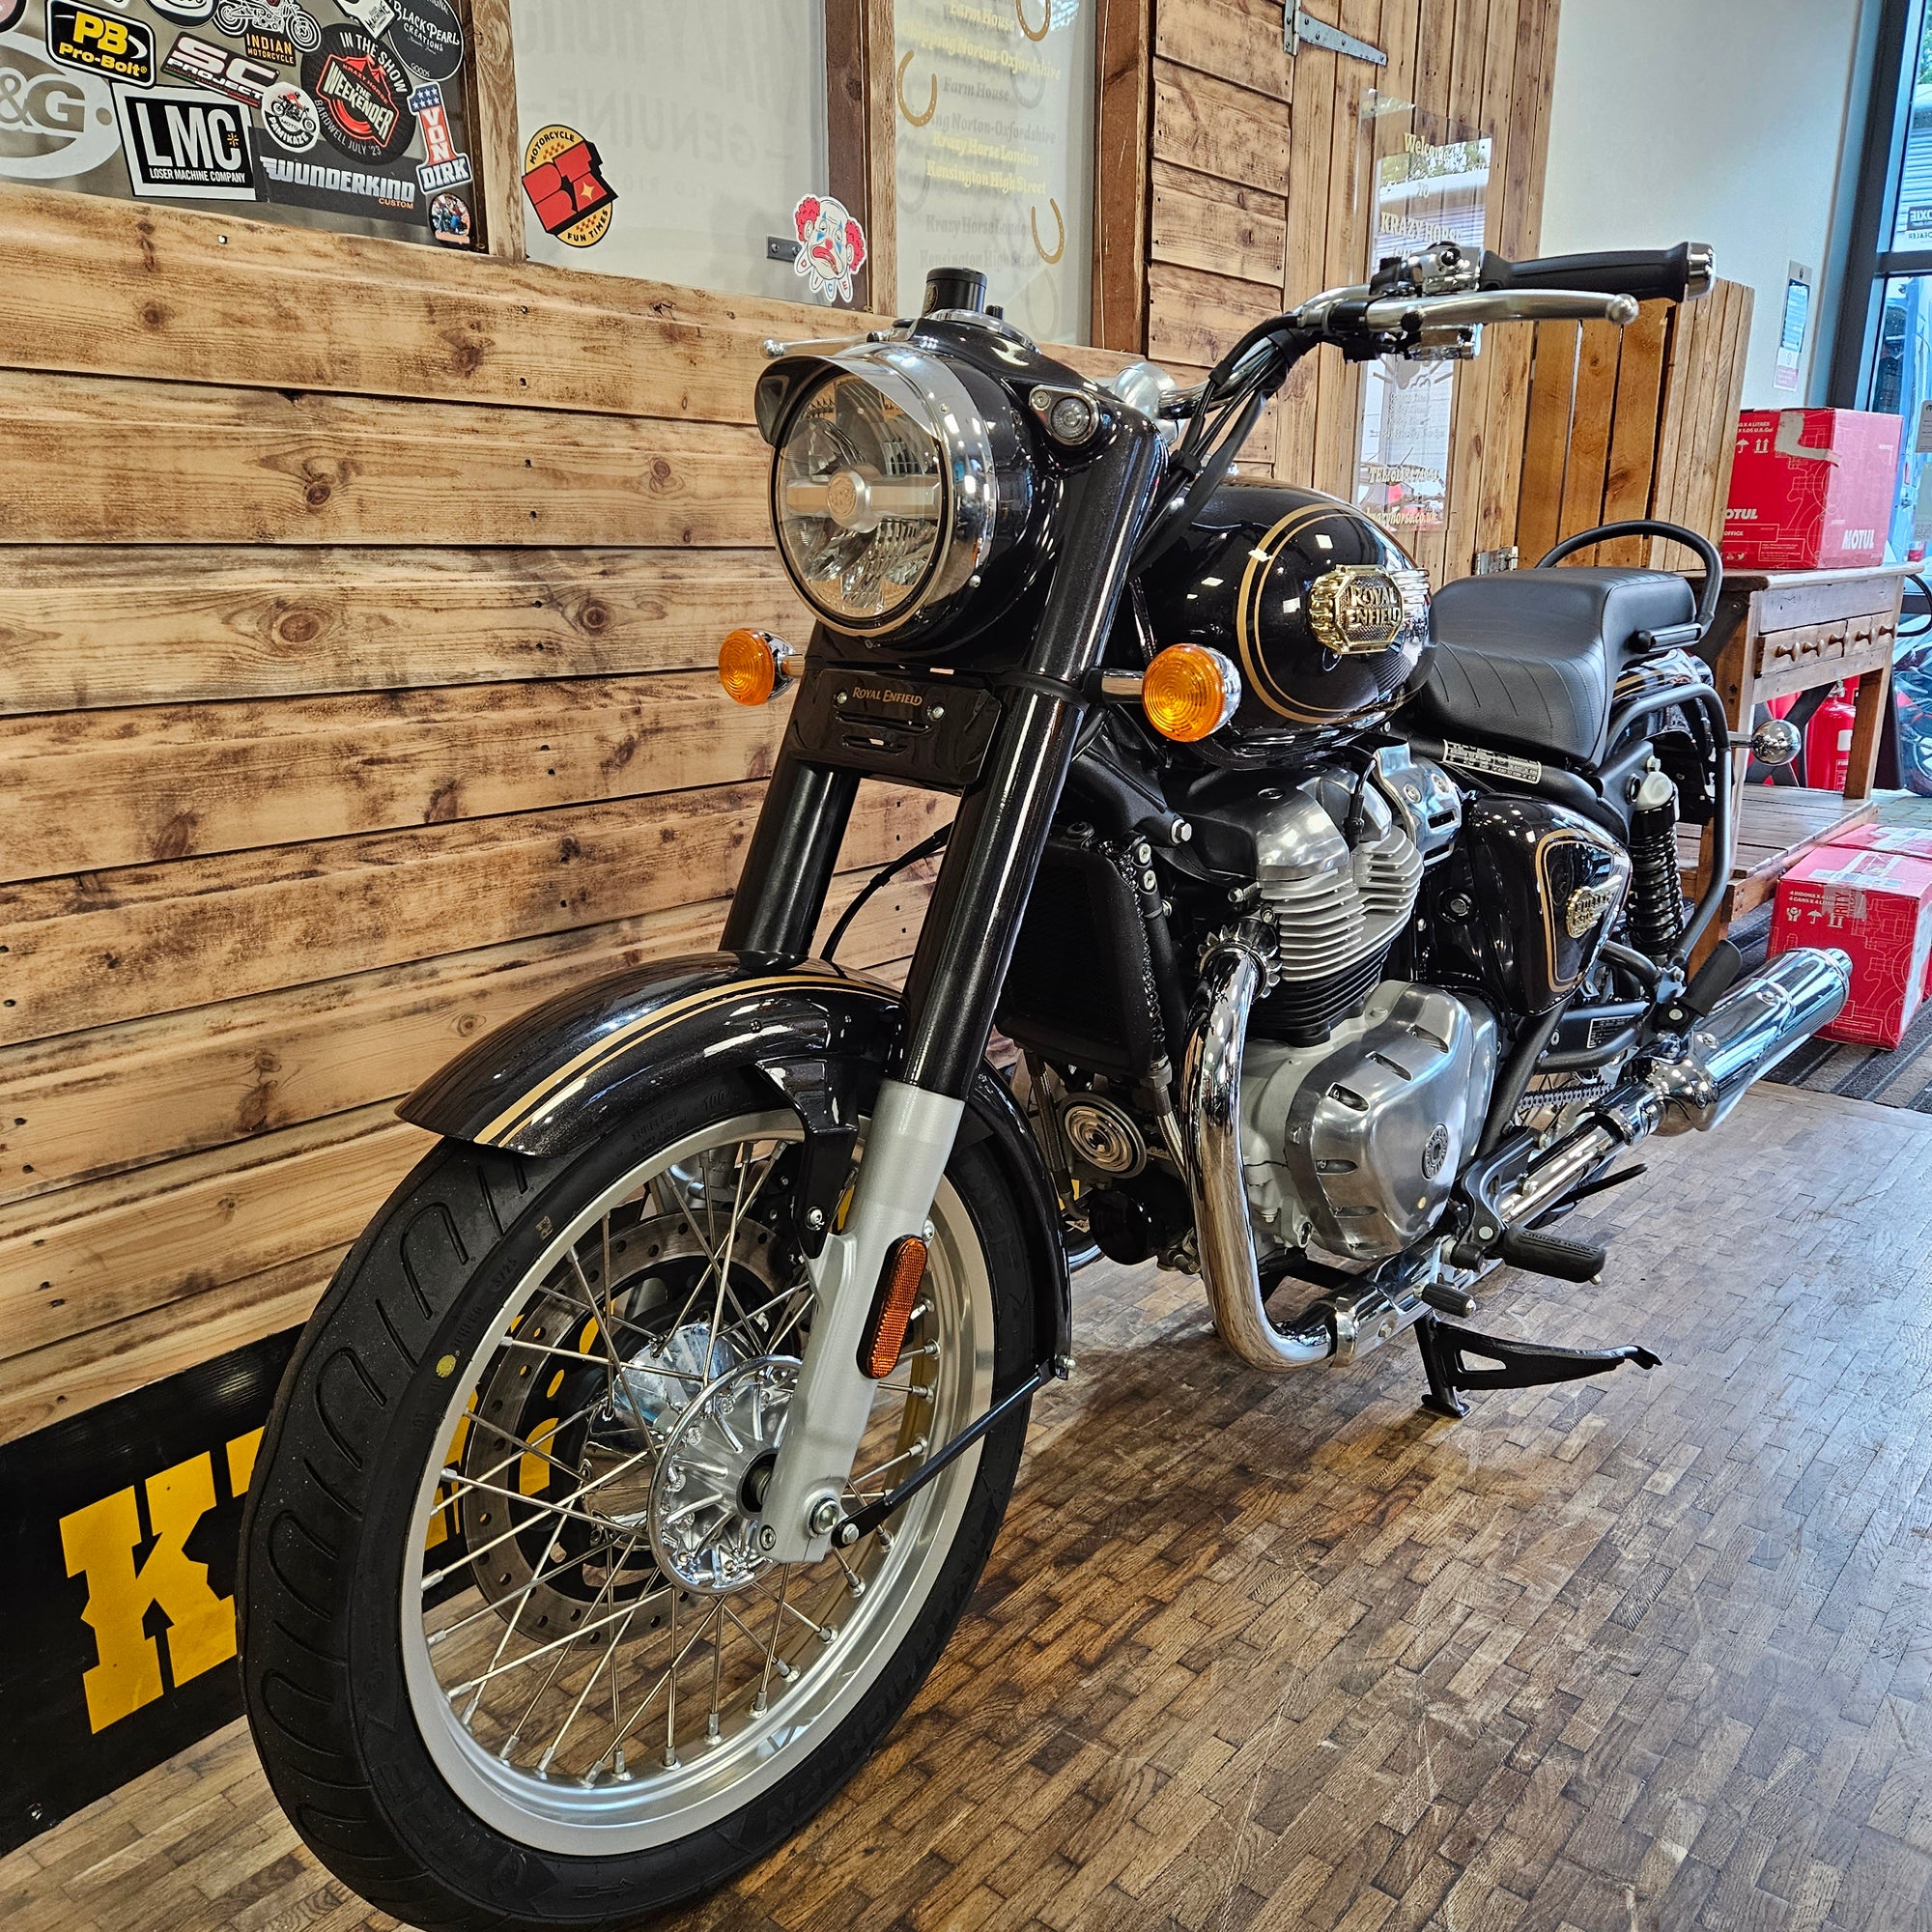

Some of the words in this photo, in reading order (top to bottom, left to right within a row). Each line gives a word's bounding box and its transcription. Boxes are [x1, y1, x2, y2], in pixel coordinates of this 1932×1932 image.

[73, 11, 128, 55] PB
[393, 1, 426, 33] BLACK
[427, 21, 460, 45] PEARL
[403, 22, 443, 52] CREATIONS
[246, 33, 293, 55] INDIAN
[247, 47, 295, 65] MOTORCYCLE
[166, 57, 265, 99] PROJECT
[171, 36, 277, 92] SC
[339, 32, 354, 49] IN
[355, 34, 379, 57] THE
[378, 51, 408, 93] SHOW
[411, 63, 430, 77] GOODS
[342, 63, 367, 81] KRAZY
[367, 79, 389, 104] HORSE
[355, 82, 373, 100] THE
[323, 61, 394, 141] WEEKENDER
[135, 102, 242, 171] LMC
[269, 117, 309, 145] PAMIKAZE
[281, 119, 298, 130] MOTO
[314, 99, 346, 146] BARDWELL
[348, 140, 367, 156] JULY
[368, 145, 382, 156] '23
[422, 108, 451, 162] VON
[529, 130, 575, 165] MOTORCYCLE
[933, 132, 967, 157] Krazy
[968, 138, 1000, 158] Horse
[1002, 145, 1040, 167] London
[149, 167, 174, 181] LOSER
[174, 169, 210, 182] MACHINE
[210, 171, 245, 184] COMPANY
[261, 156, 415, 203] WUNDERKIND
[420, 157, 469, 190] DIRK
[926, 159, 991, 188] Kensington
[990, 171, 1016, 193] High
[379, 198, 413, 210] CUSTOM
[567, 233, 586, 242] FUN
[589, 210, 609, 238] TIMES
[1379, 212, 1427, 240] KRAZY
[1842, 529, 1875, 550] MOTUL
[1349, 584, 1398, 608] ROYAL
[1346, 607, 1402, 629] ENFIELD
[852, 687, 882, 700] ROYAL
[882, 690, 923, 706] ENFIELD
